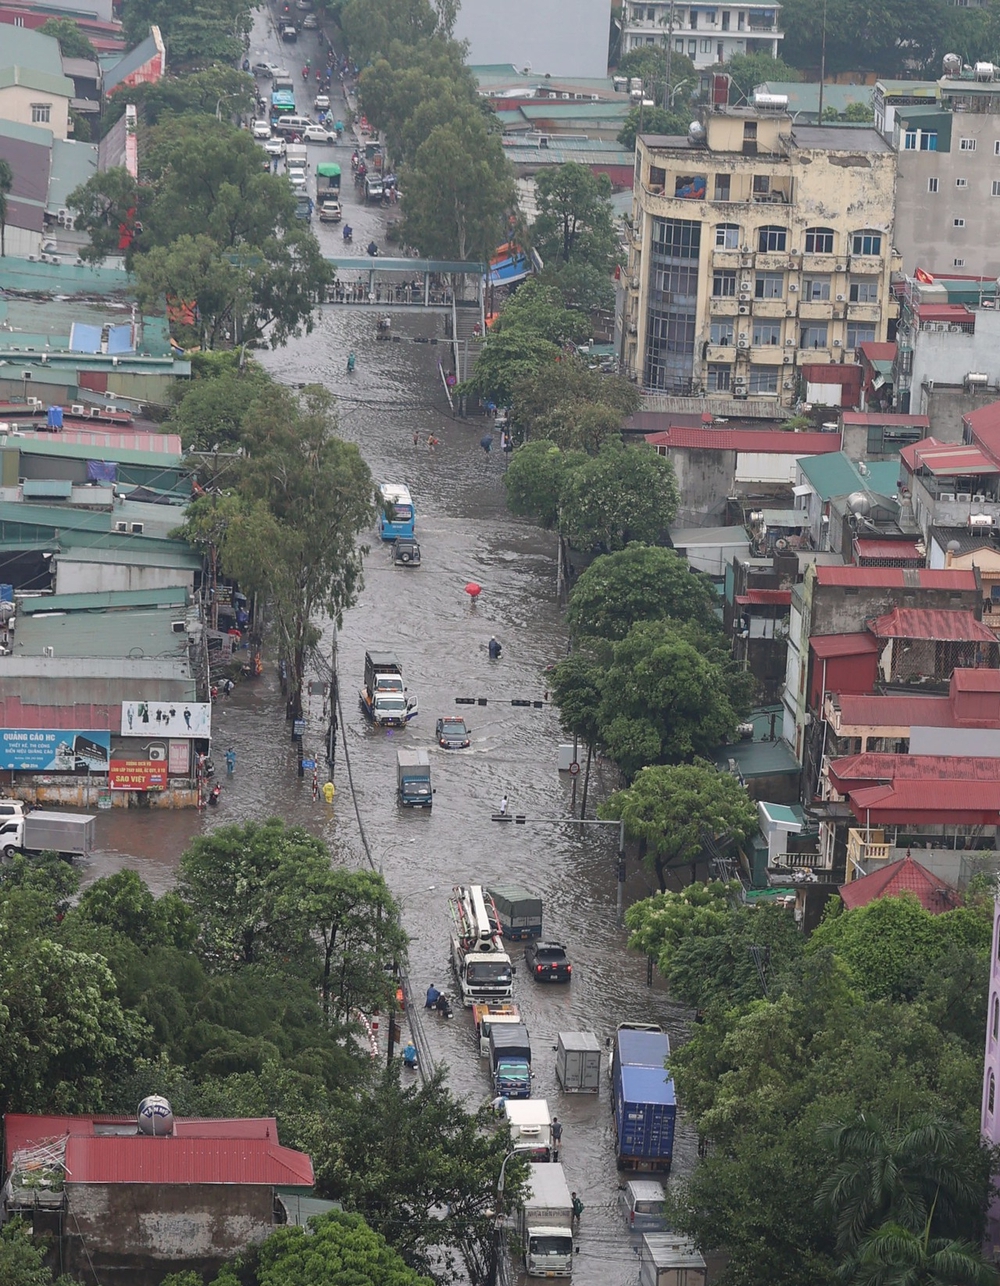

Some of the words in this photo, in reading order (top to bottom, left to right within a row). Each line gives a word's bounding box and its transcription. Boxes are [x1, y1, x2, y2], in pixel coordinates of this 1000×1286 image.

[3, 730, 28, 741] QUẢNG
[29, 732, 44, 741] CÁO
[45, 733, 56, 741] HC
[115, 775, 130, 783] SAO
[130, 775, 146, 784] VIỆT
